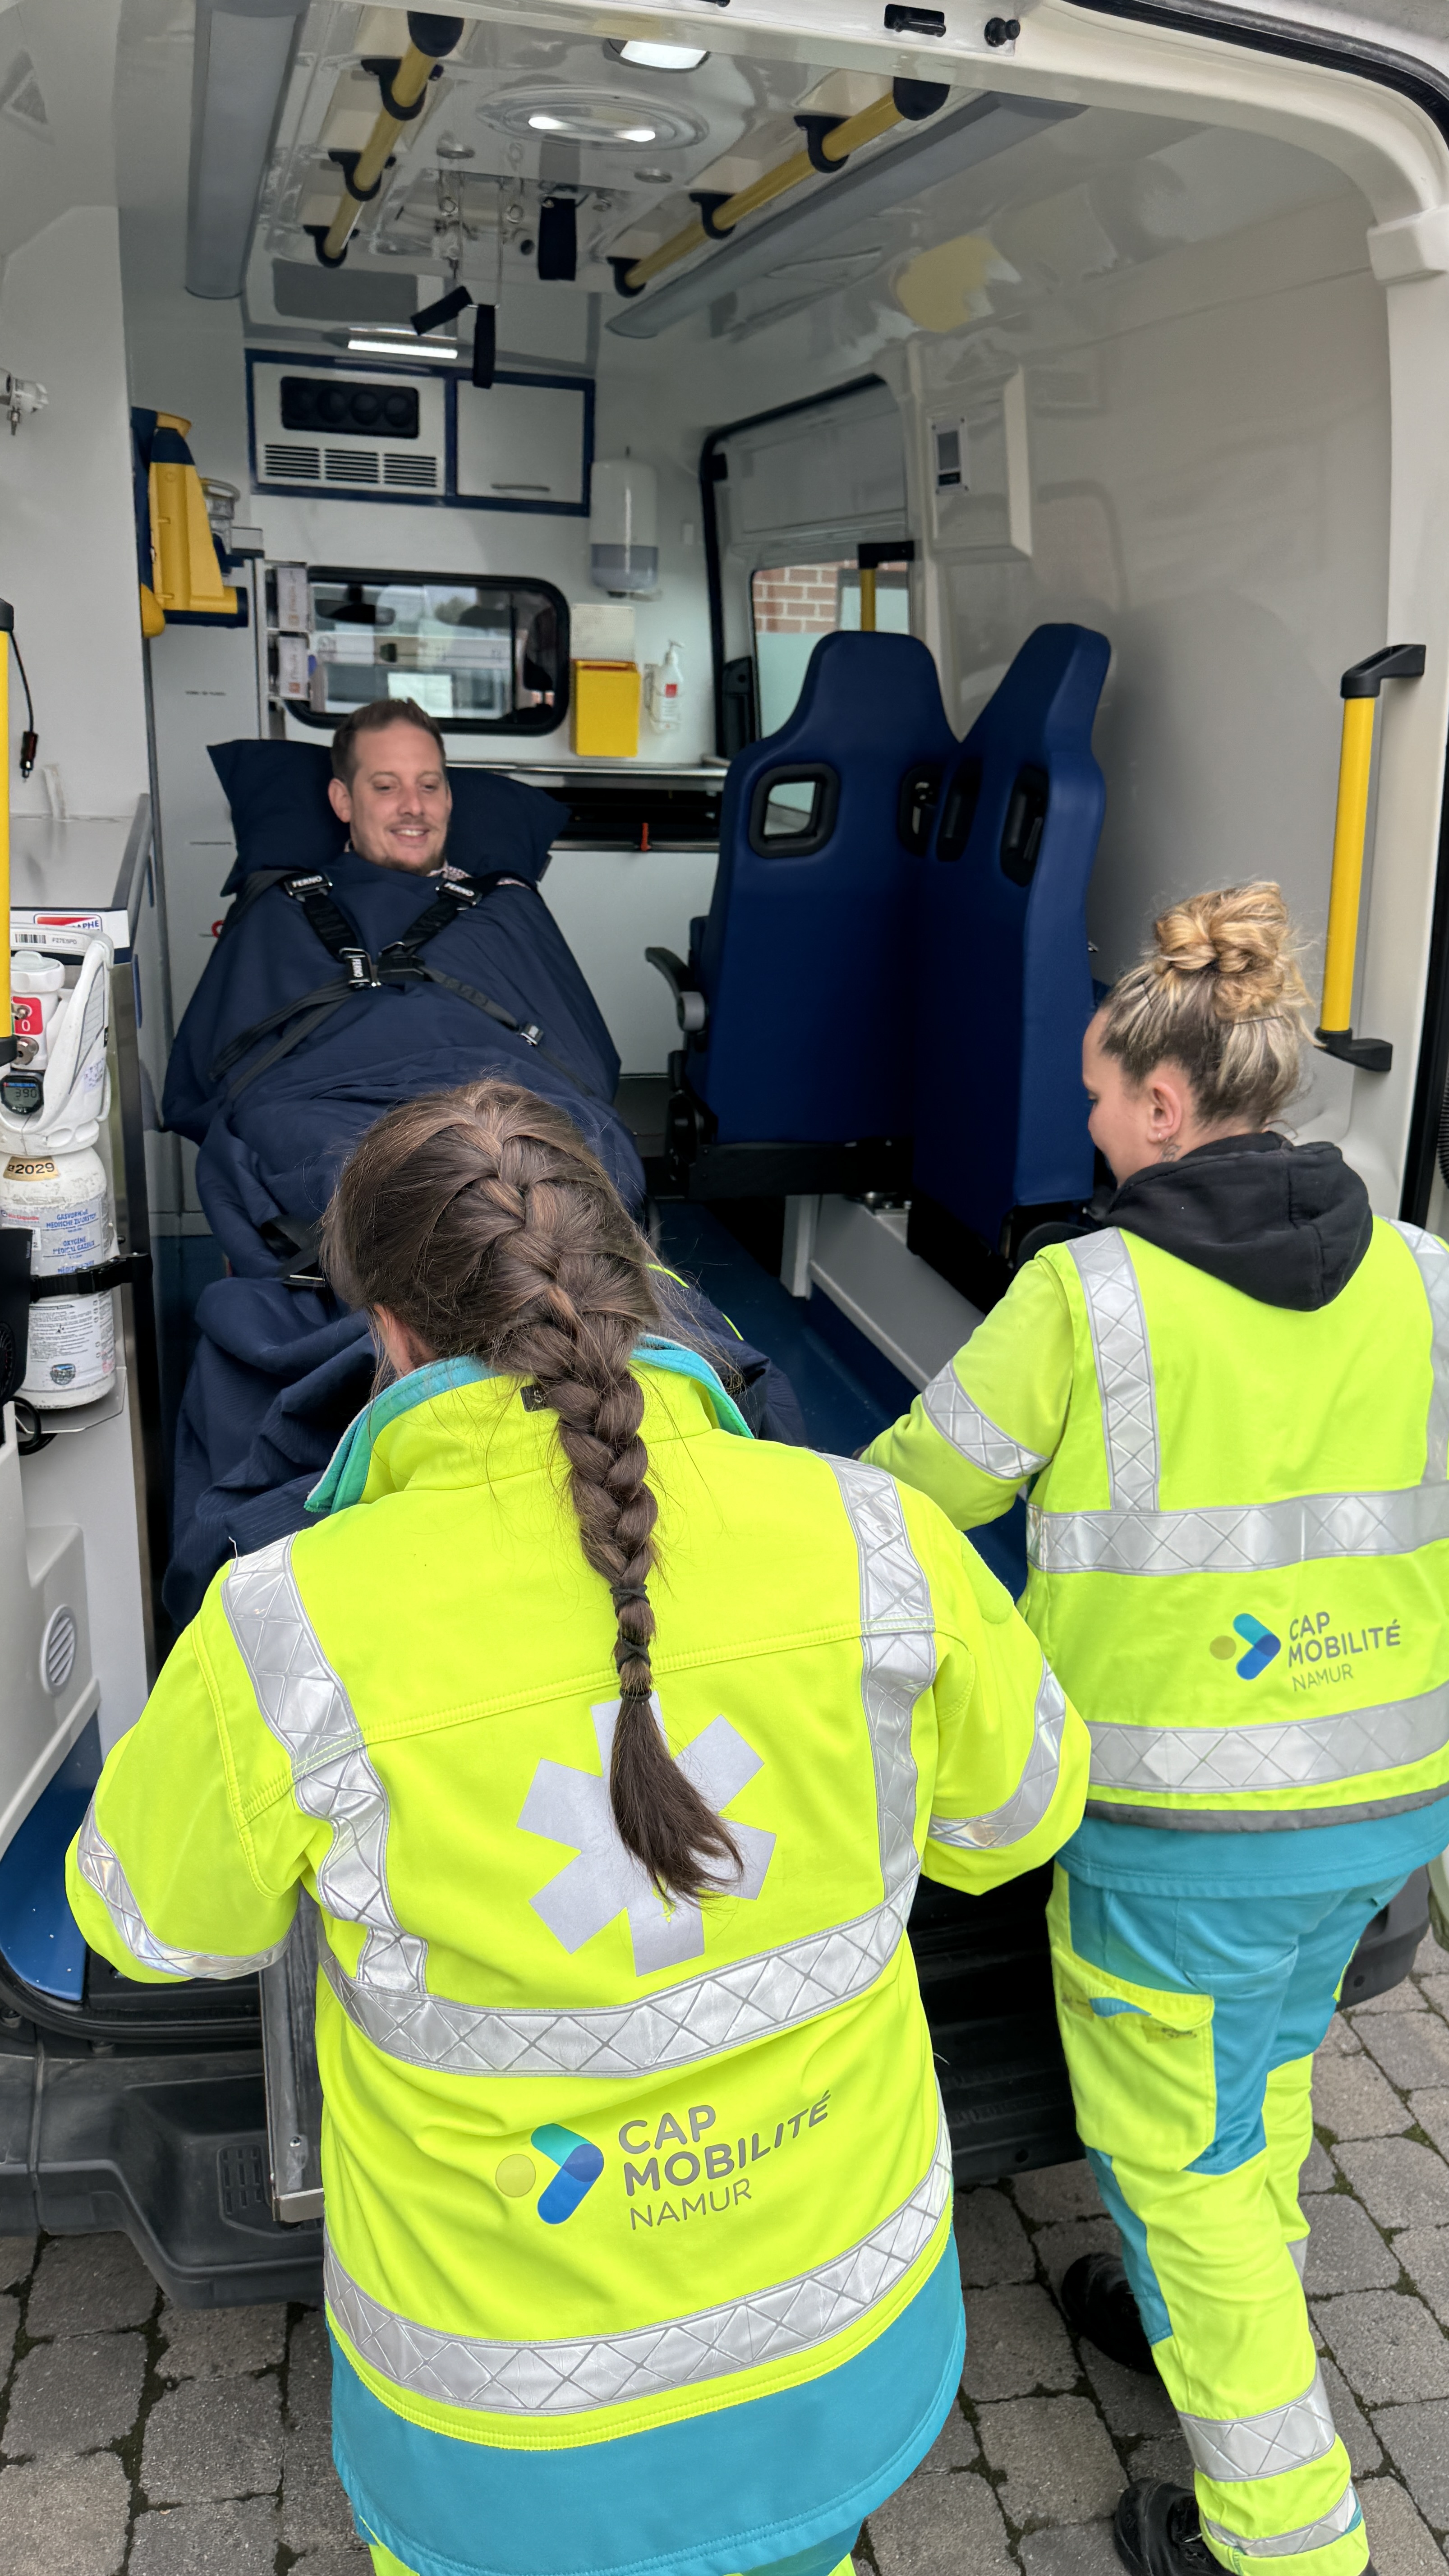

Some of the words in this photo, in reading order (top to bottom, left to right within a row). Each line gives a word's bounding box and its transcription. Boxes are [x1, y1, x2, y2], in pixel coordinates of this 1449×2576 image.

[15, 1163, 55, 1174] 2029
[1288, 1611, 1330, 1641] CAP
[1288, 1619, 1401, 1668] MOBILITÉ
[1292, 1663, 1354, 1693] NAMUR
[618, 2105, 716, 2155] CAP
[623, 2089, 832, 2197] MOBILITÉ
[630, 2178, 752, 2230] NAMUR
